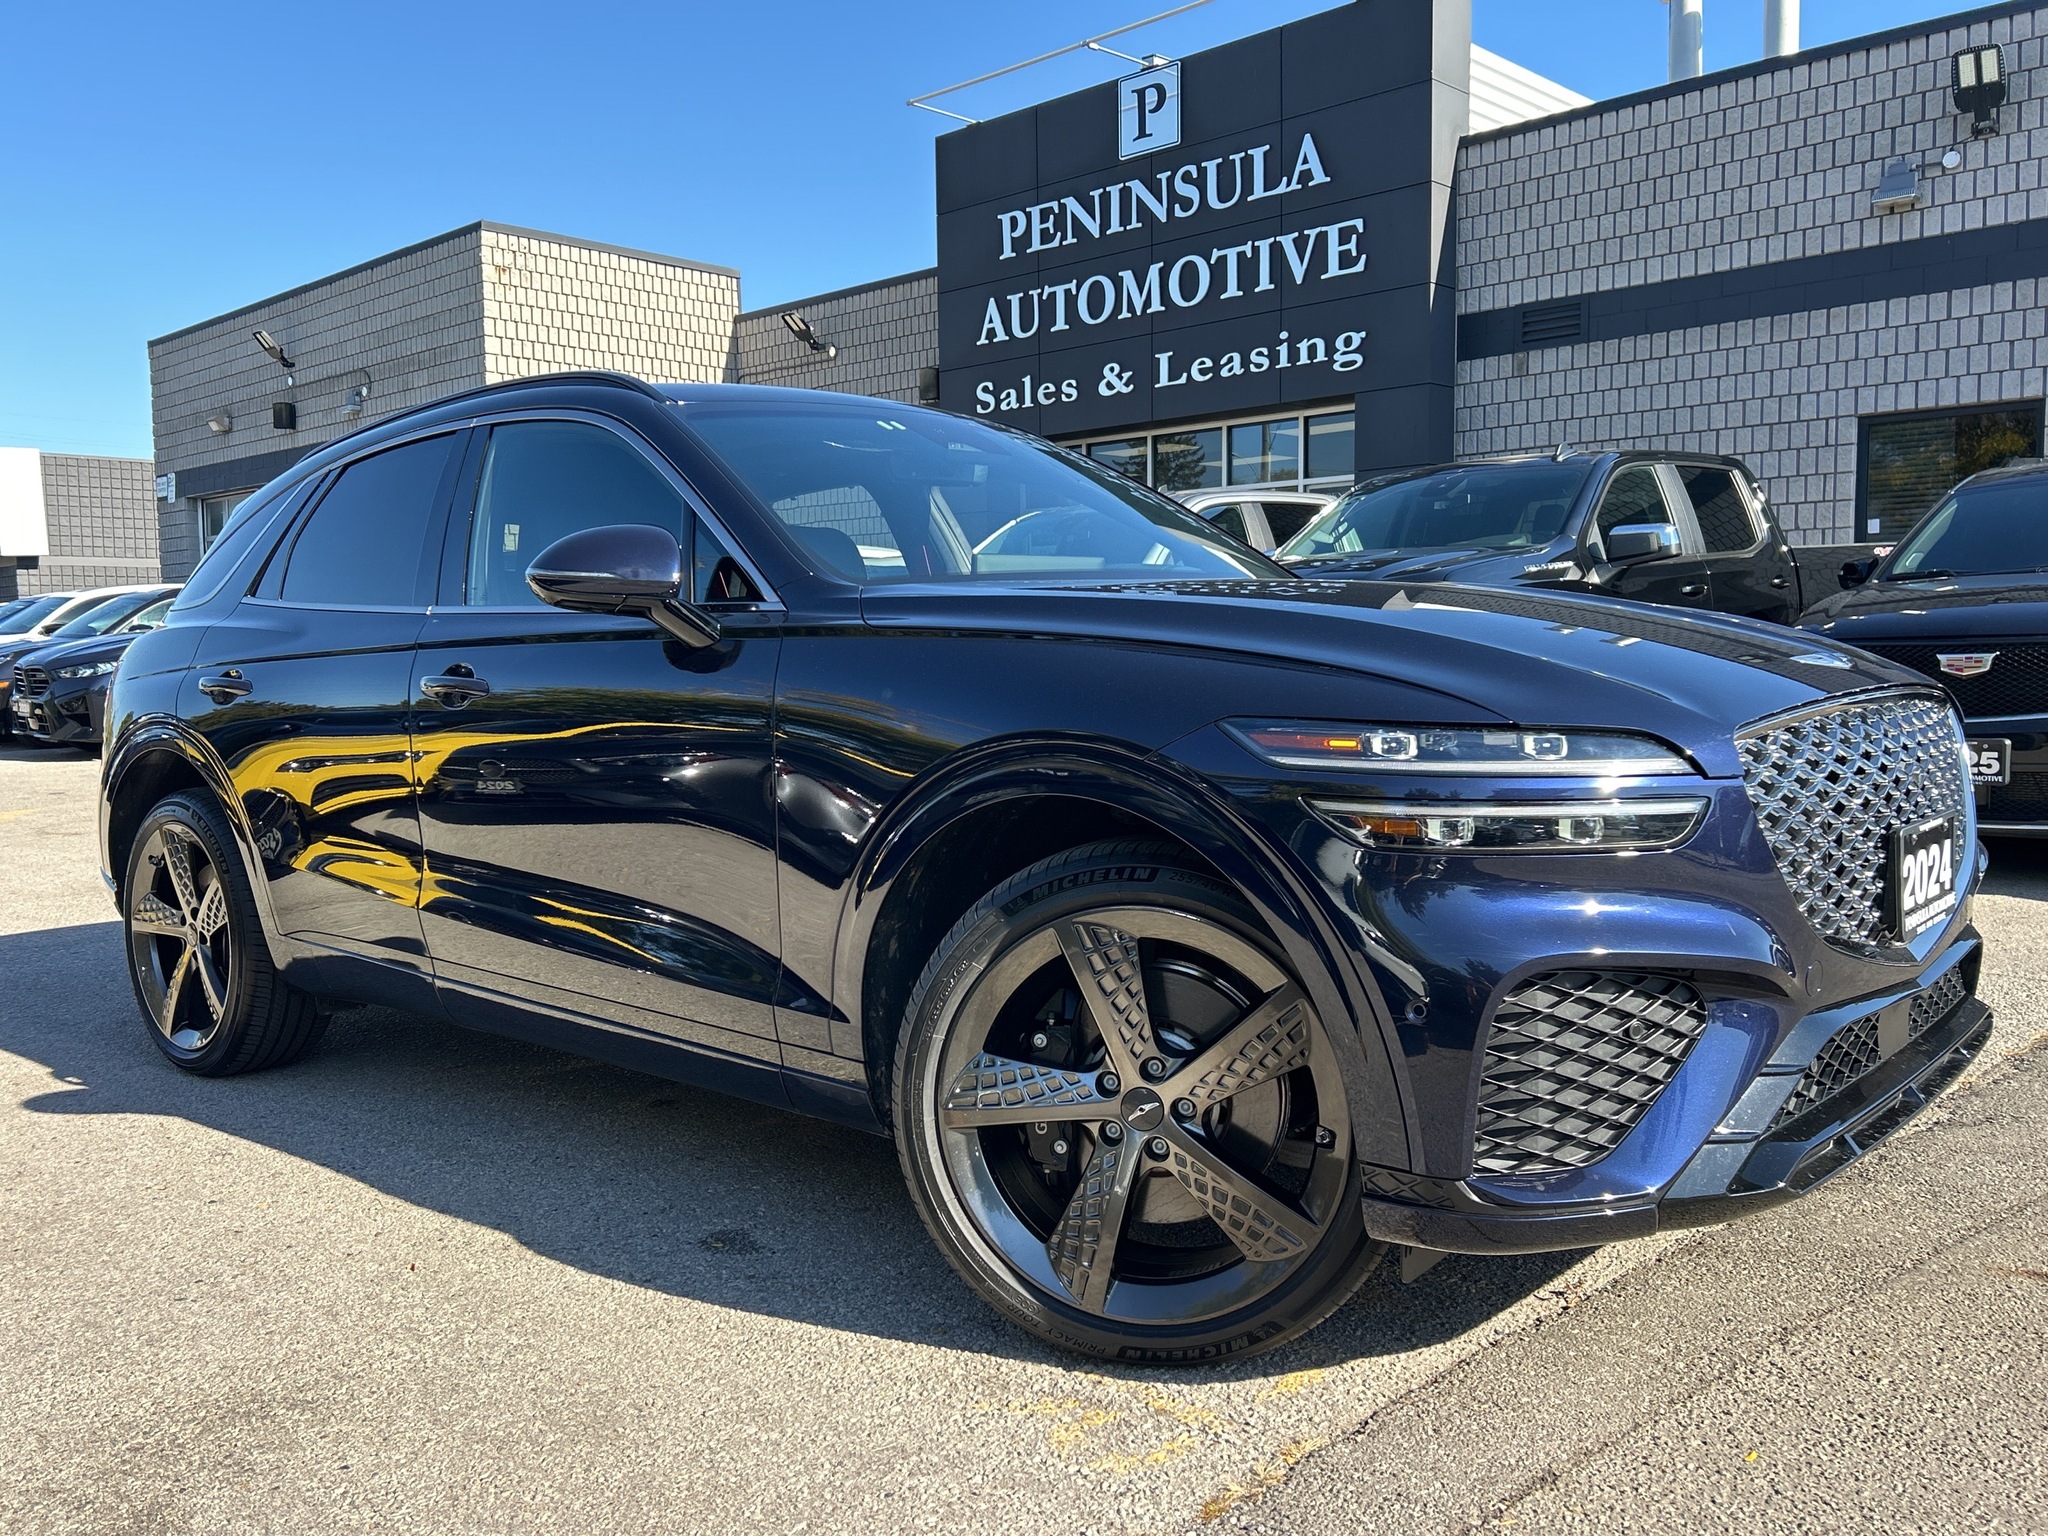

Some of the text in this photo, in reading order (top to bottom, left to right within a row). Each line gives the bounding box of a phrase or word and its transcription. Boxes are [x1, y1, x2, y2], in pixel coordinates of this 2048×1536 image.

[1132, 82, 1168, 142] P
[997, 133, 1331, 260] PENINSULA
[976, 218, 1367, 346] AUTOMOTIVE
[975, 330, 1367, 414] Sales & Leasing
[198, 821, 229, 872] MICHELIN
[1032, 867, 1153, 899] MICHELIN
[1168, 871, 1220, 891] 255/40
[1902, 838, 1953, 911] 2024
[1007, 1303, 1041, 1328] TOUR
[1043, 1328, 1106, 1355] PRIMACY
[1125, 1335, 1250, 1360] MICHELIN
